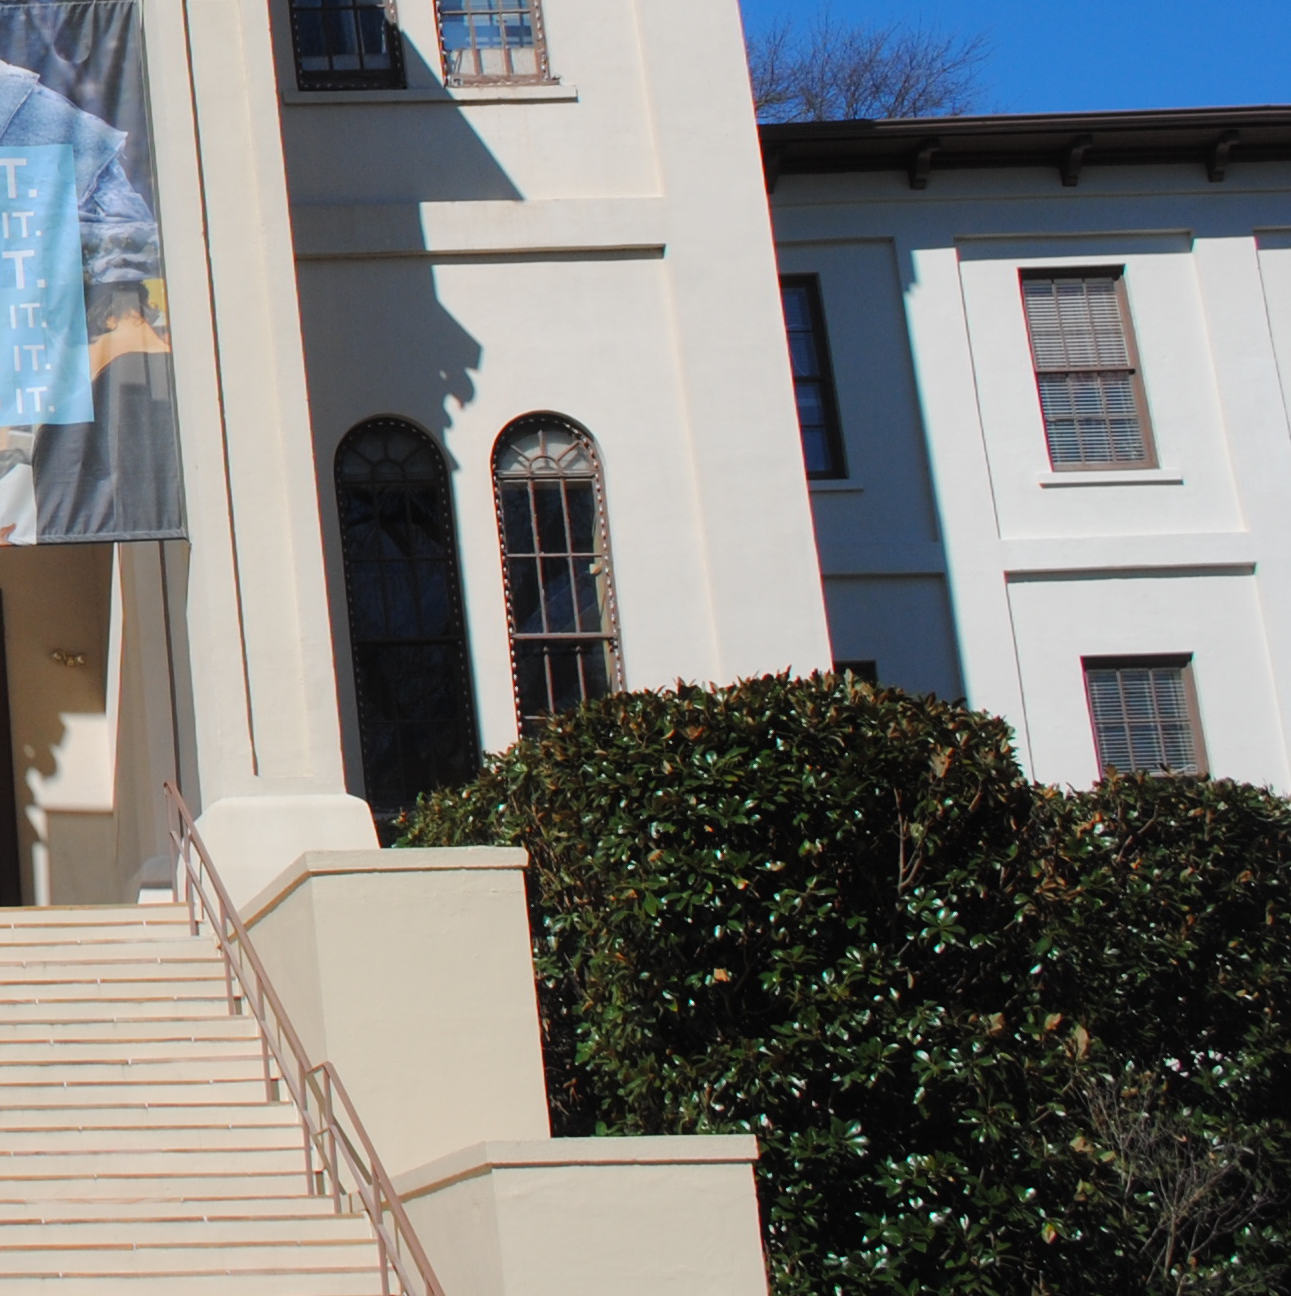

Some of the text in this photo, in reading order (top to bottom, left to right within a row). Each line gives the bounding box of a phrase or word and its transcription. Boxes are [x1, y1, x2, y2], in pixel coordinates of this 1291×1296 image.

[3, 211, 42, 238] IT.
[10, 303, 47, 330] IT.
[14, 345, 52, 373] IT.
[17, 386, 55, 414] IT.
